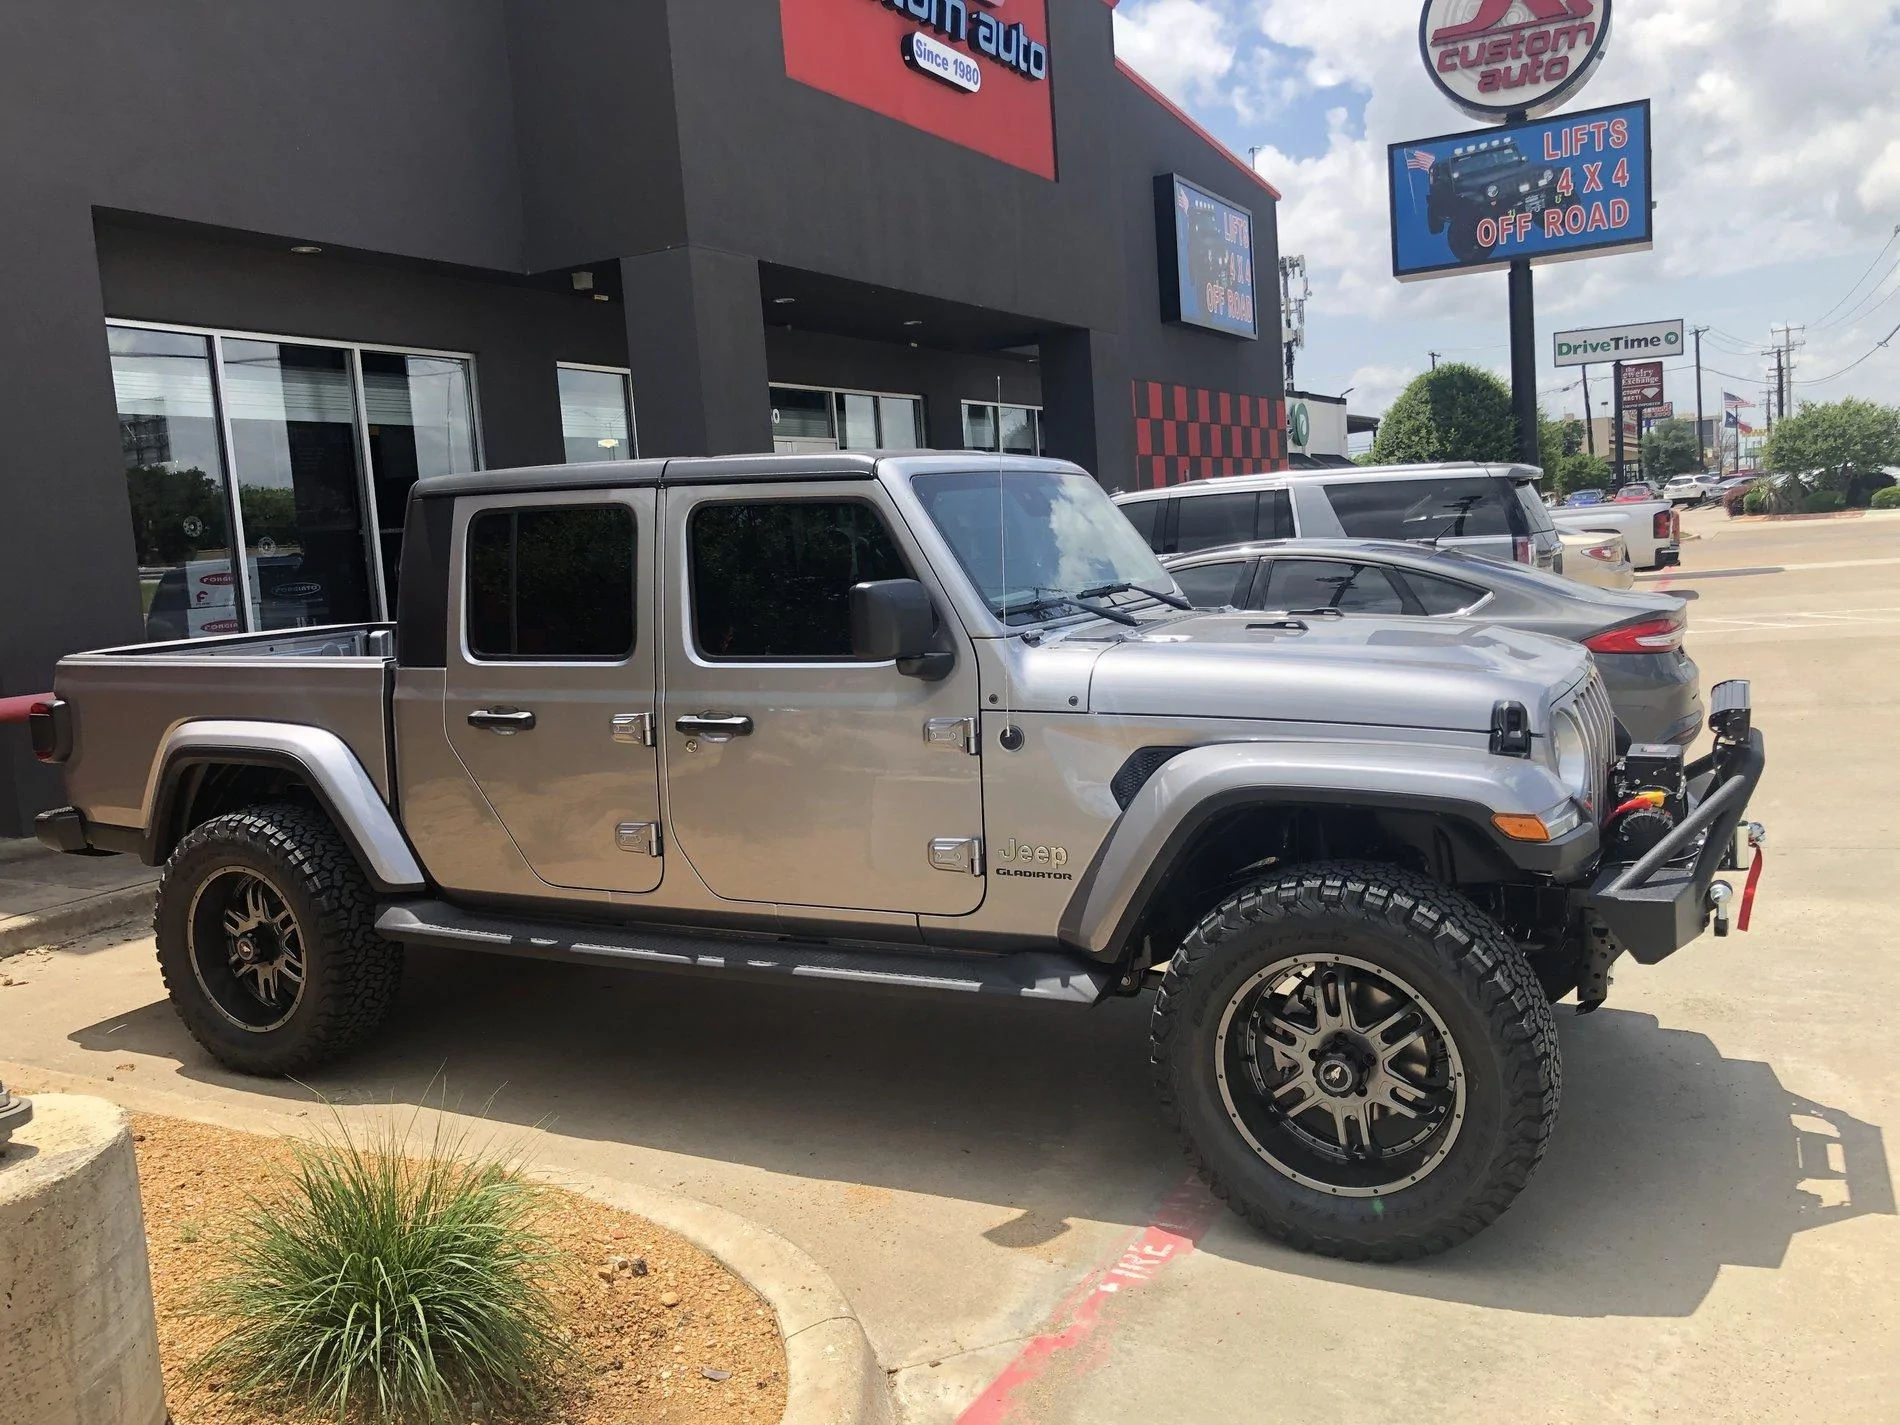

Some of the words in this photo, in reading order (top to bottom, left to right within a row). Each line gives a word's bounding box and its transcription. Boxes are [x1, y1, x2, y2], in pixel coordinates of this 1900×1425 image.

[915, 39, 949, 71] Since
[952, 57, 979, 86] 1980
[979, 11, 1046, 80] auto
[1437, 21, 1596, 73] custom
[1478, 55, 1570, 93] auto
[1543, 118, 1628, 160] LIFTS
[1557, 167, 1573, 196] 4
[1583, 162, 1603, 193] X
[1612, 158, 1629, 187] 4
[1477, 213, 1533, 247] OFF
[1544, 198, 1630, 238] ROAD
[1206, 282, 1225, 315] OFF
[1227, 289, 1253, 322] ROAD
[1557, 336, 1661, 357] DriveTime
[1622, 368, 1654, 380] ewelry
[998, 838, 1068, 870] Jeep
[996, 868, 1072, 880] GLADIATOR
